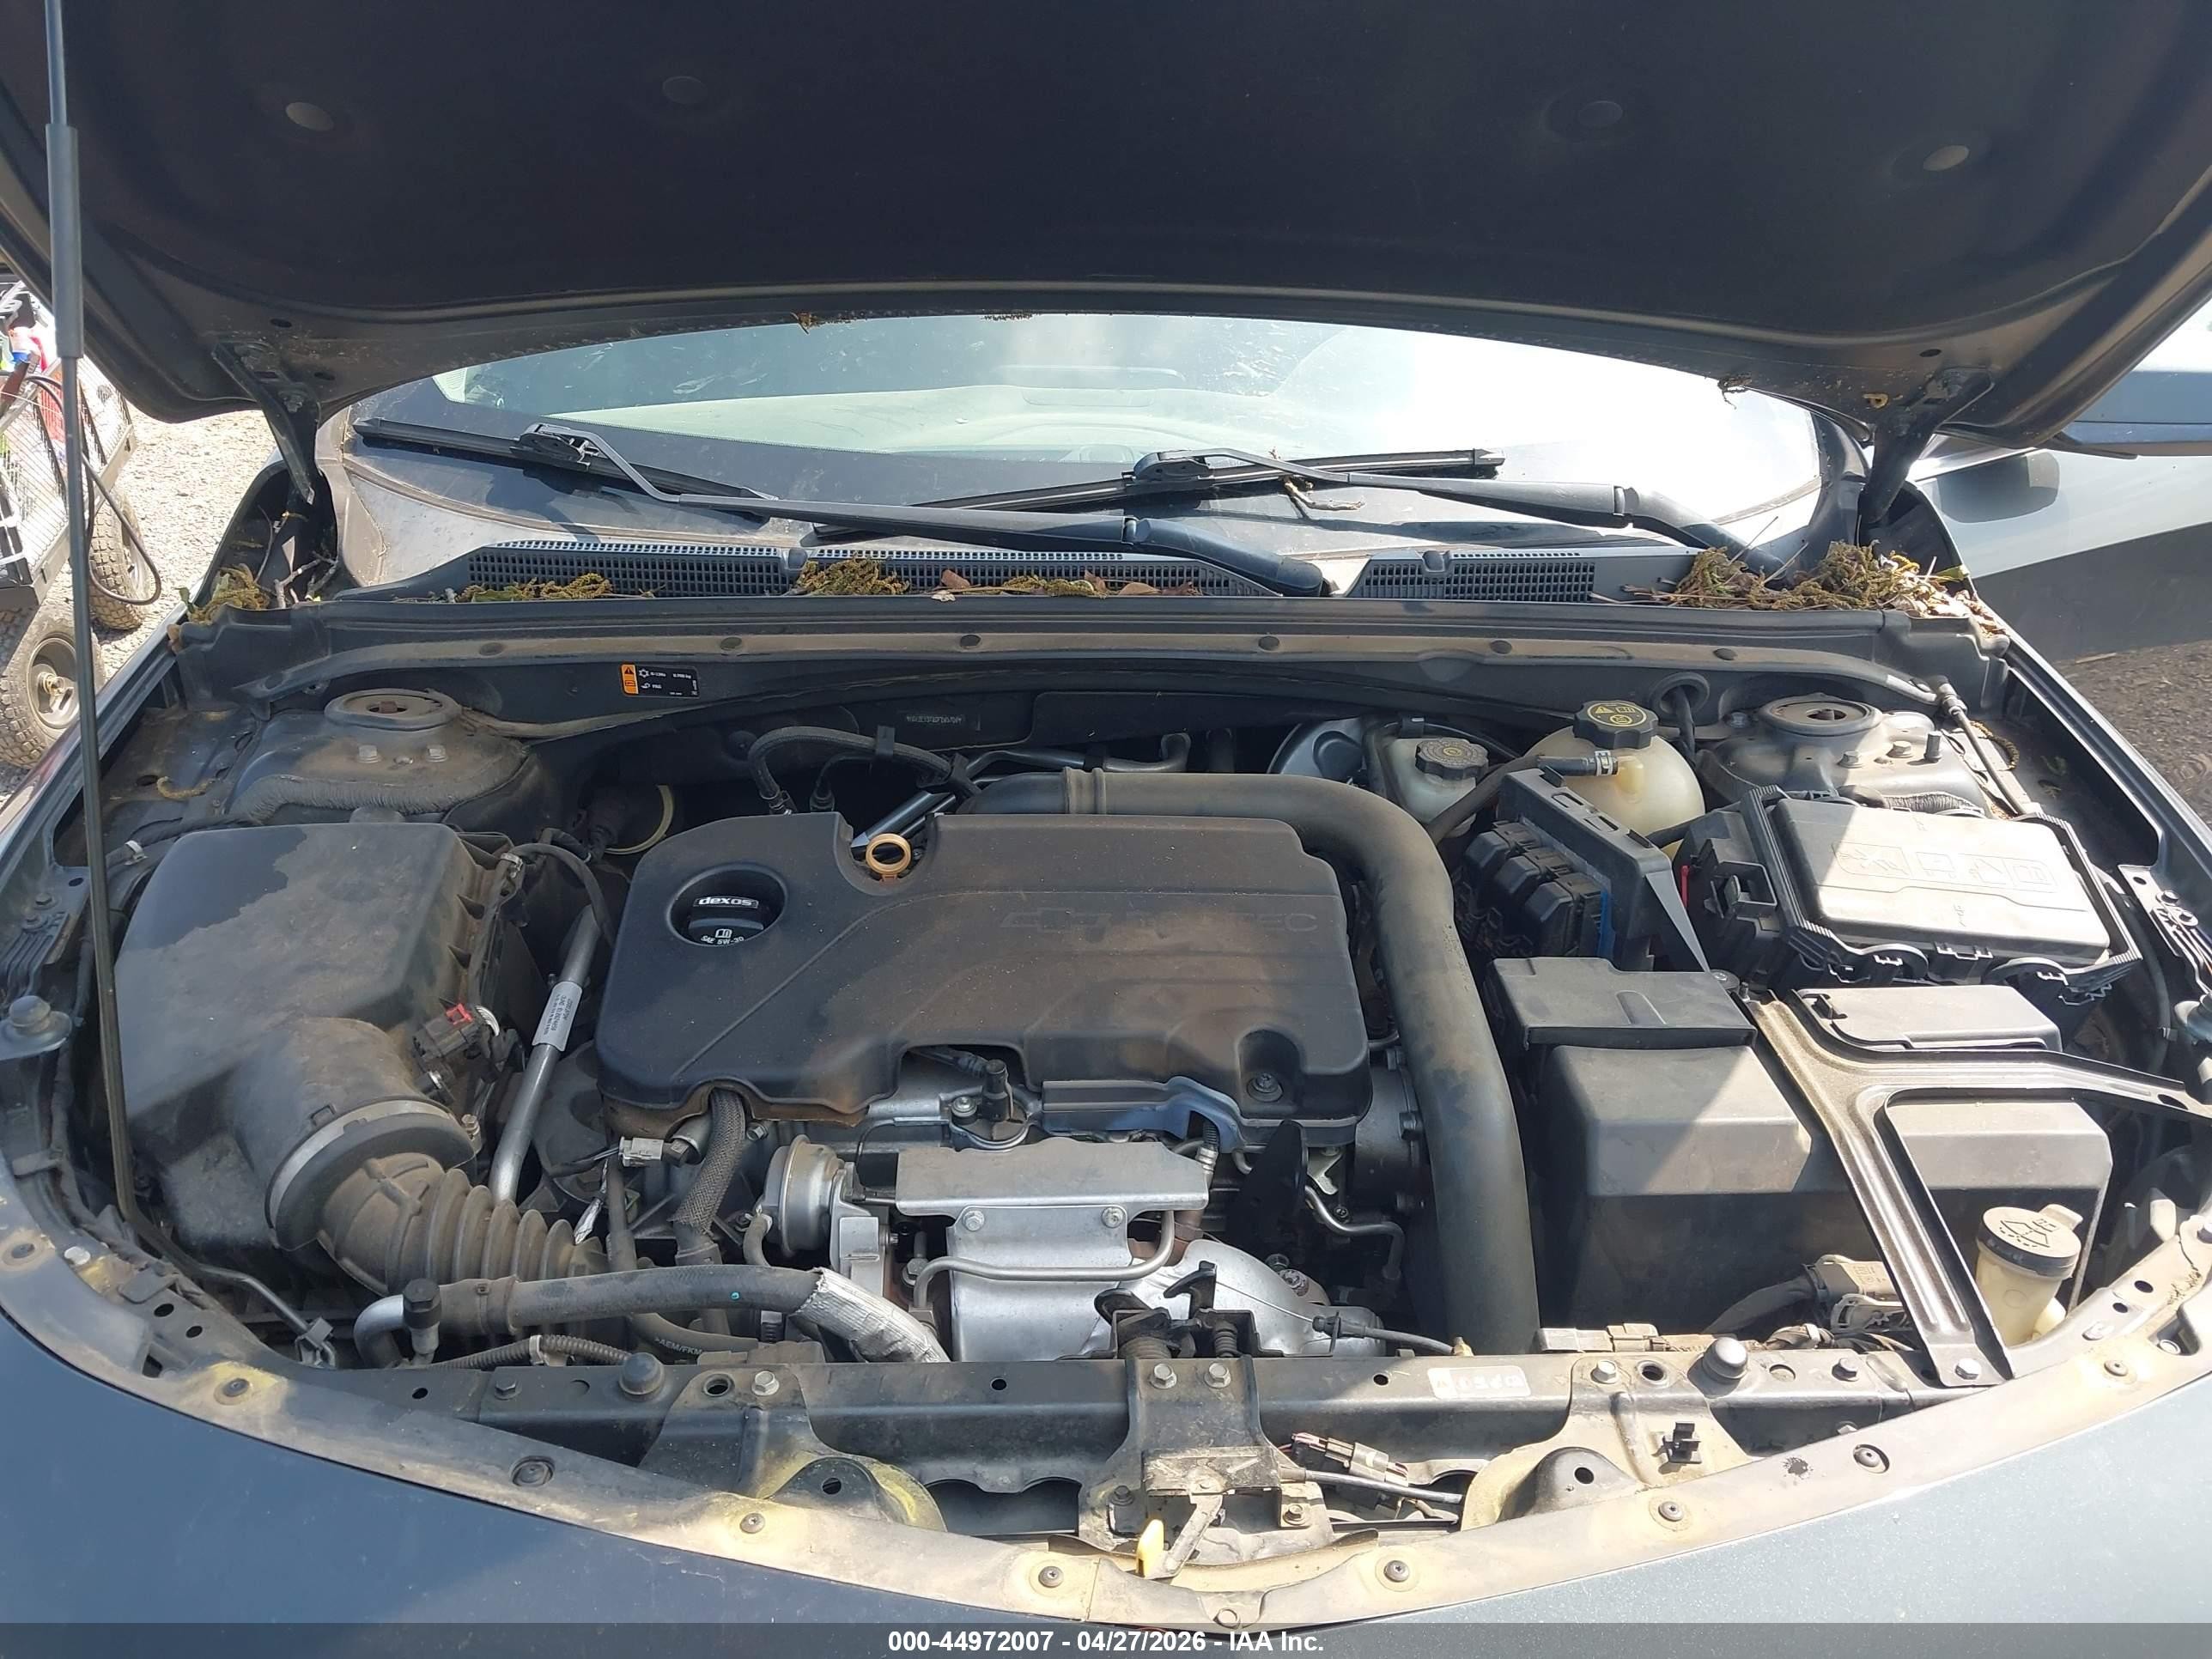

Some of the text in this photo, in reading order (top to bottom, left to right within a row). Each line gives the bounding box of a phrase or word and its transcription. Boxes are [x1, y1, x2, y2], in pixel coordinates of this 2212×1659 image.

[698, 896, 752, 906] dexos
[701, 935, 744, 945] SAE 5W-30
